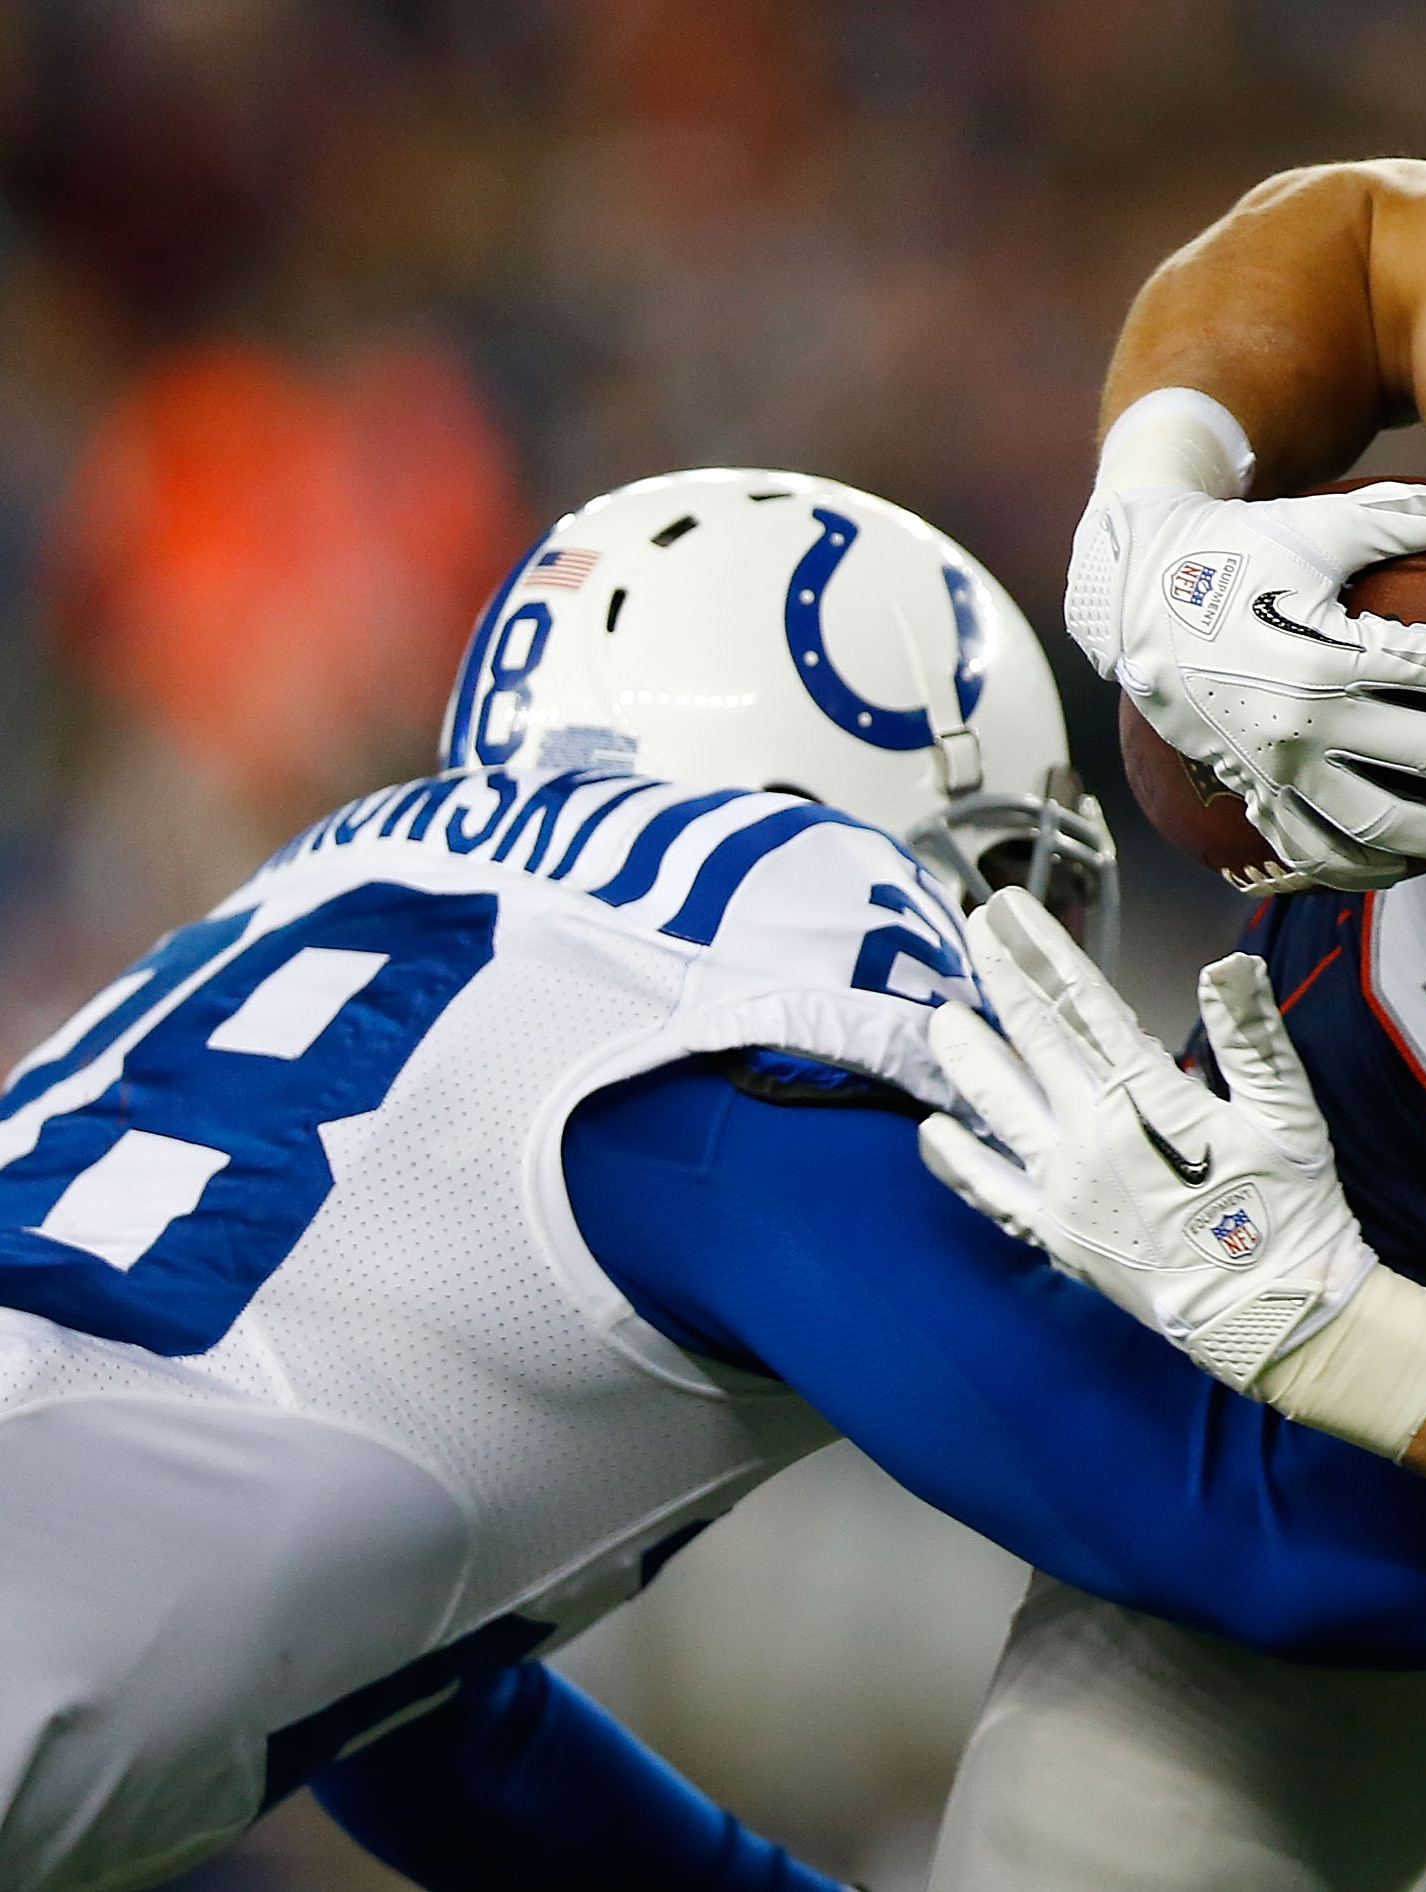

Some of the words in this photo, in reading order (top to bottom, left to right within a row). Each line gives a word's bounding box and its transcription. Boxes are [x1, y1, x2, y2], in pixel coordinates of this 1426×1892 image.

[1173, 564, 1203, 597] NFL
[1200, 557, 1238, 627] EQUIPMENT
[265, 763, 672, 880] OWSKI
[1221, 1225, 1259, 1255] NFL
